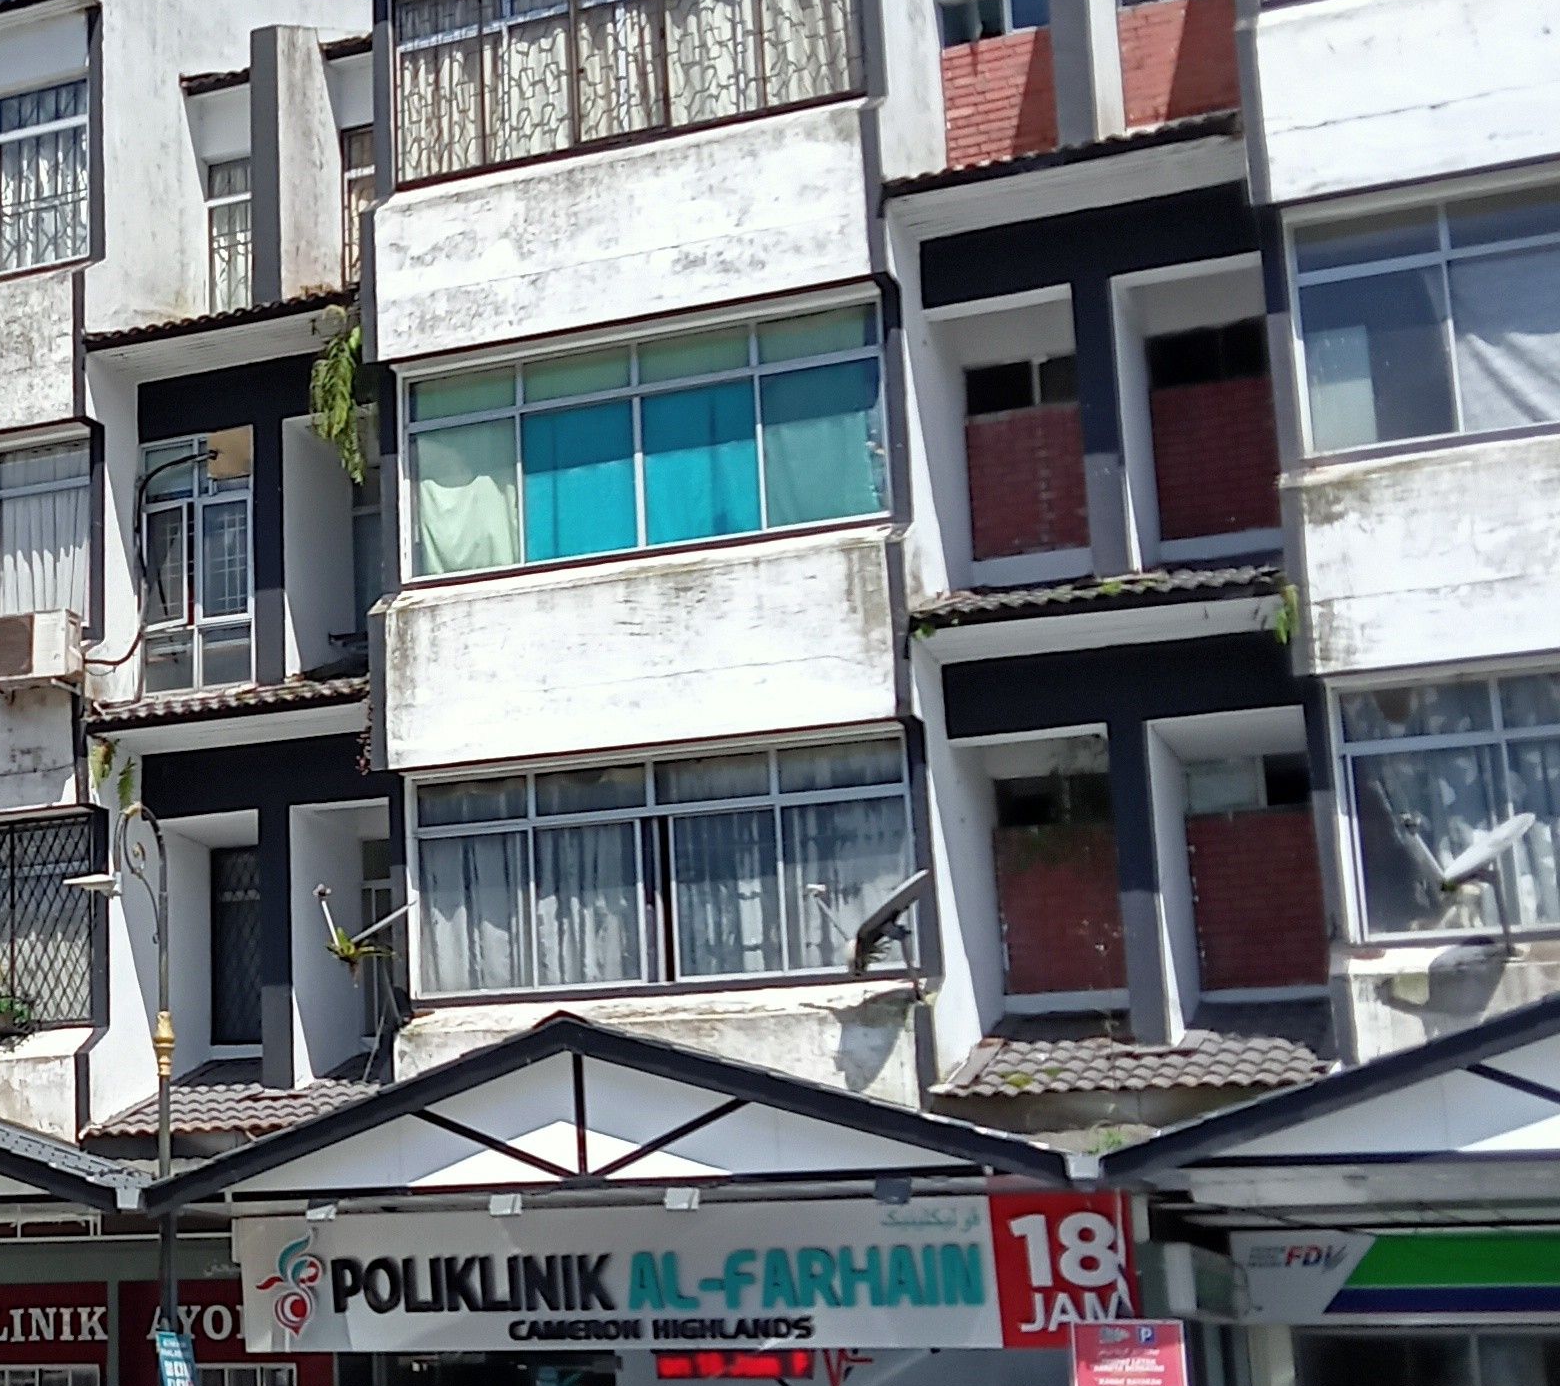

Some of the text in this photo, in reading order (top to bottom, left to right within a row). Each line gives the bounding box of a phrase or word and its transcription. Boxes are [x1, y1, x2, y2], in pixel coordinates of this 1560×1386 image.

[330, 1243, 986, 1314] POLIKLINIK AL-FARHAIN
[1010, 1212, 1119, 1289] 18
[509, 1316, 814, 1341] CAMERON HIGHLANDS
[1020, 1292, 1122, 1334] JAM
